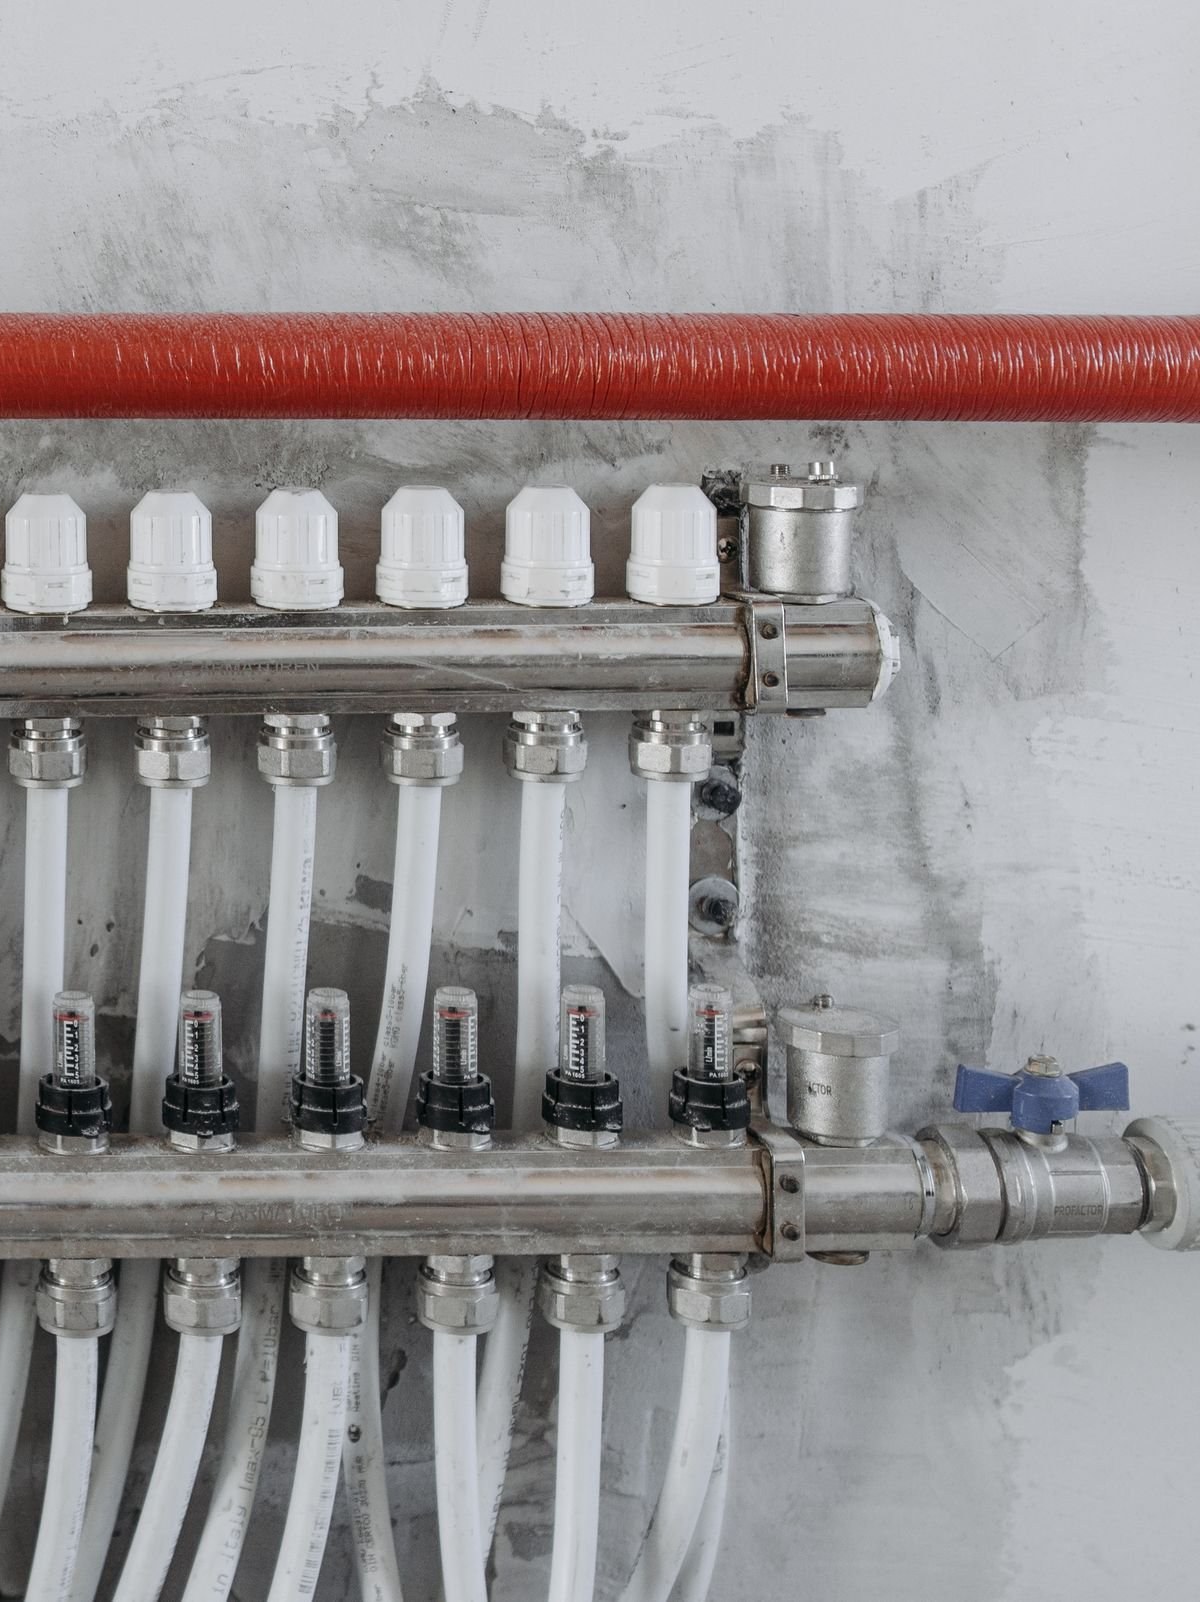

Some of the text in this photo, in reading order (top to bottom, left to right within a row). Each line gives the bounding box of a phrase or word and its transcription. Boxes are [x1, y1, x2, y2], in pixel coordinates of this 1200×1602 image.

[1054, 1205, 1104, 1217] PROFACTOR
[219, 1505, 247, 1560] Italy
[211, 1573, 229, 1596] in
